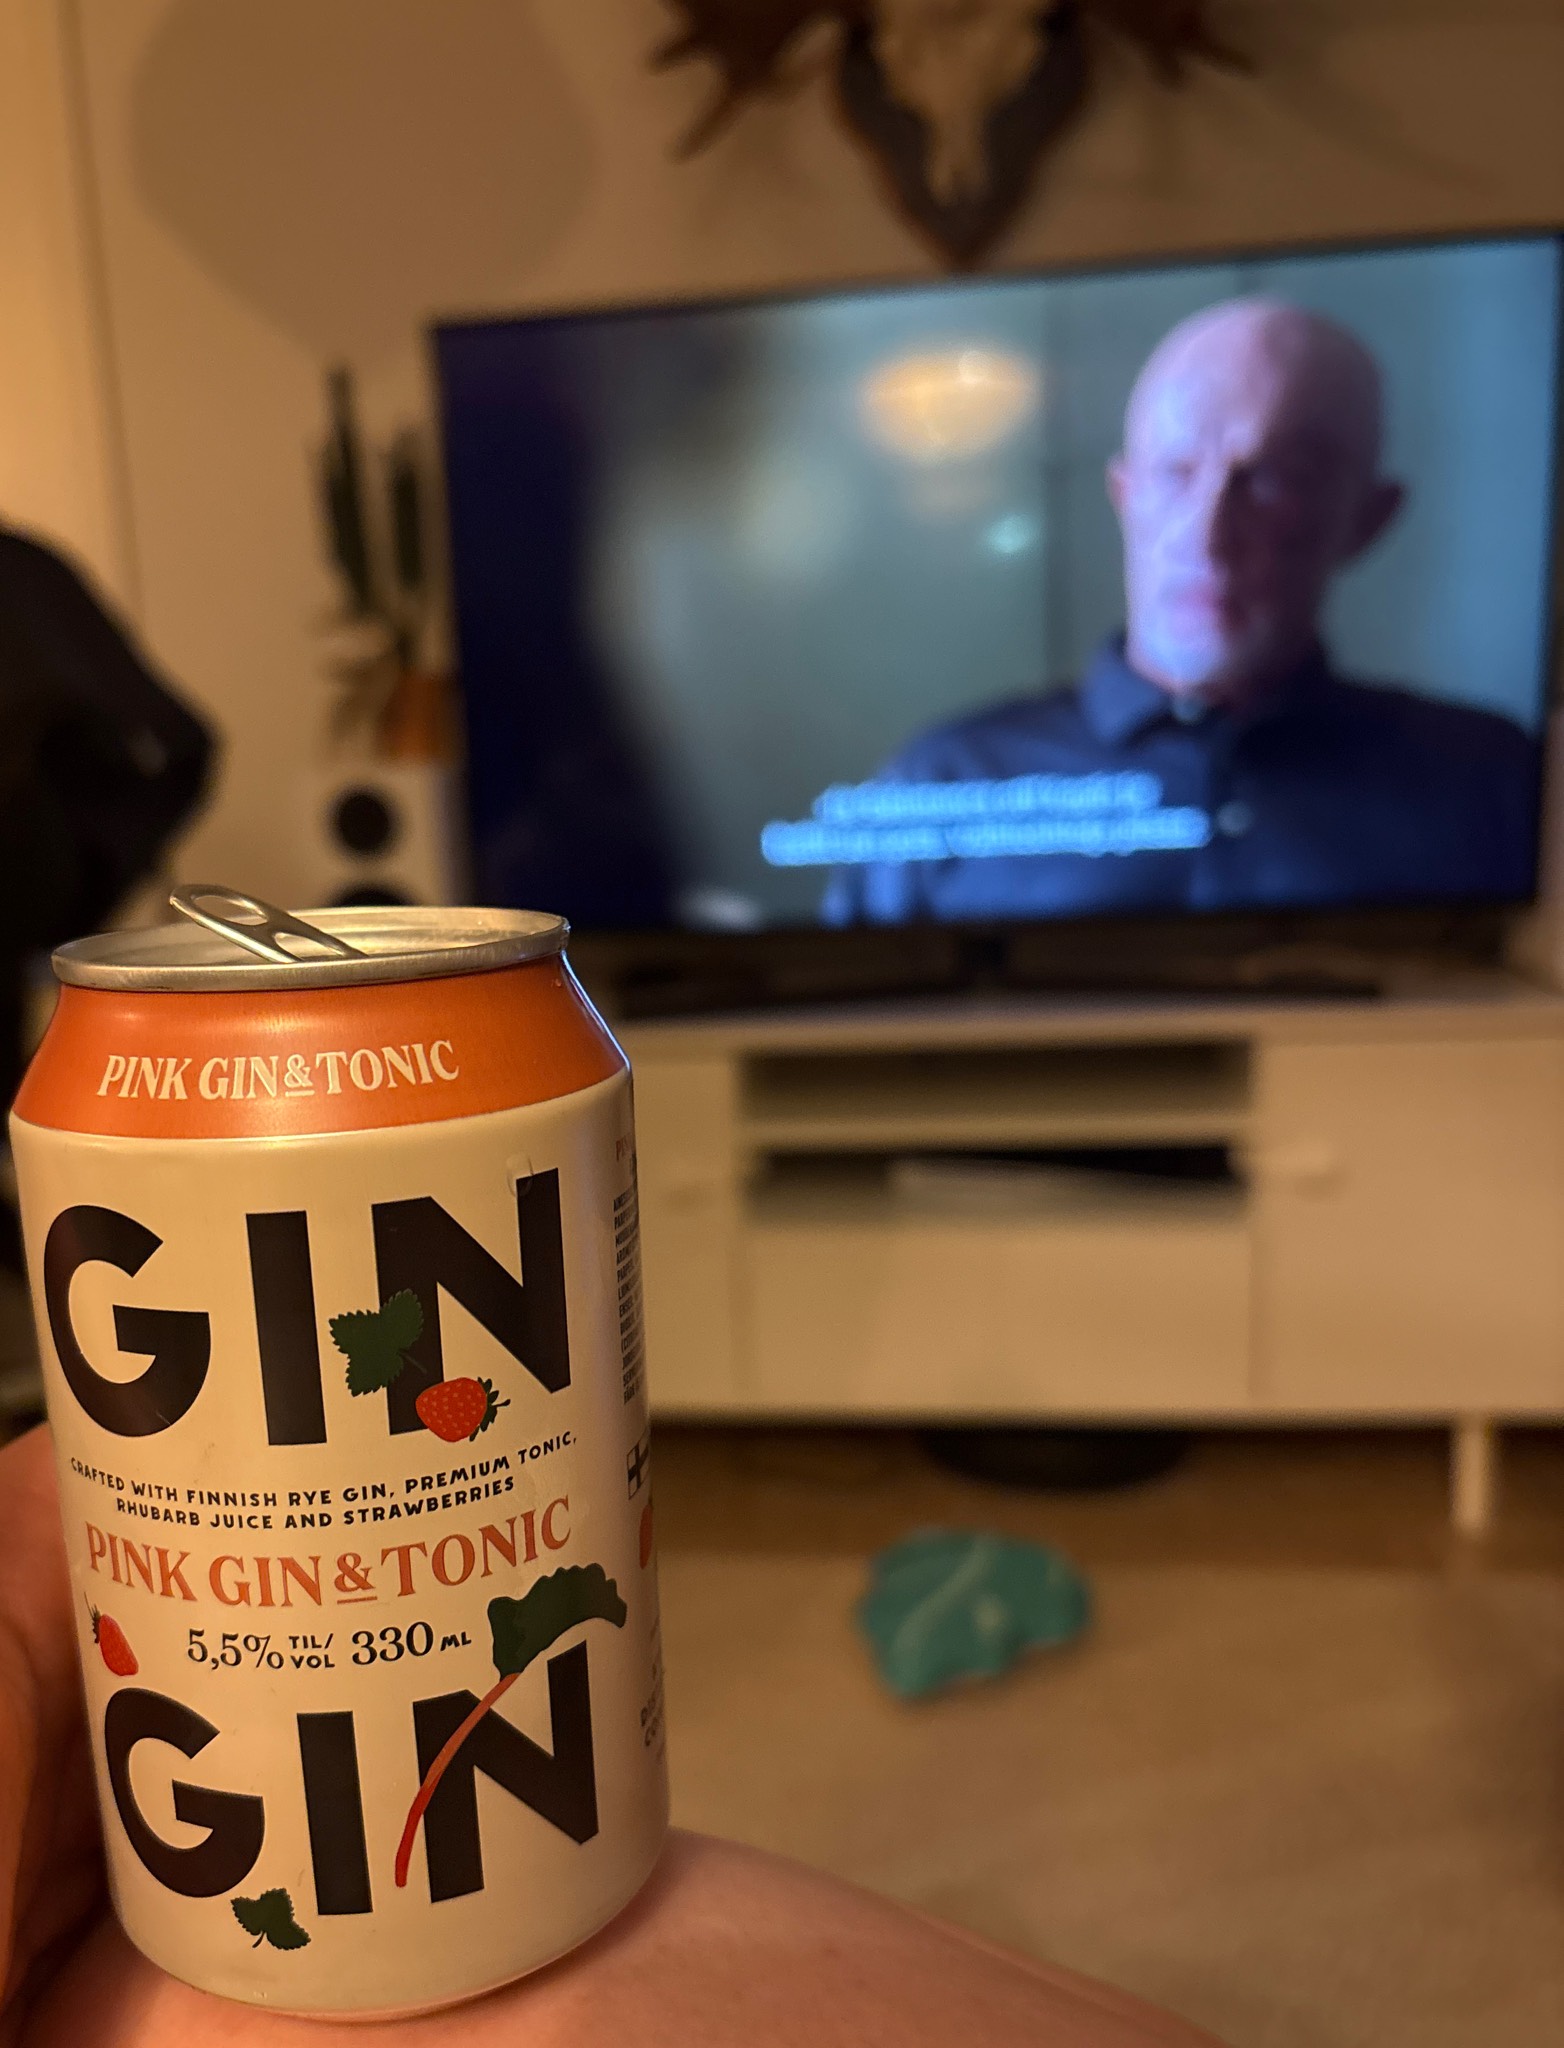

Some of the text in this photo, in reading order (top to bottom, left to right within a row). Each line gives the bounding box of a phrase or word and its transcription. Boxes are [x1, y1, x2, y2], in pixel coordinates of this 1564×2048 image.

[97, 1054, 192, 1100] PINK
[44, 1168, 571, 1446] GIN
[71, 1431, 577, 1506] CRAFTED WITH FINNISH RYE GIN, PREMIUM TONIC,
[117, 1476, 514, 1529] RHUBARB JUICE AND STRAWBERRIES
[85, 1521, 198, 1602] PINK
[187, 1628, 285, 1670] 5,5%
[351, 1621, 434, 1665] 330
[440, 1631, 472, 1651] ML
[290, 1654, 335, 1669] VOL
[105, 1639, 599, 1915] GIN
